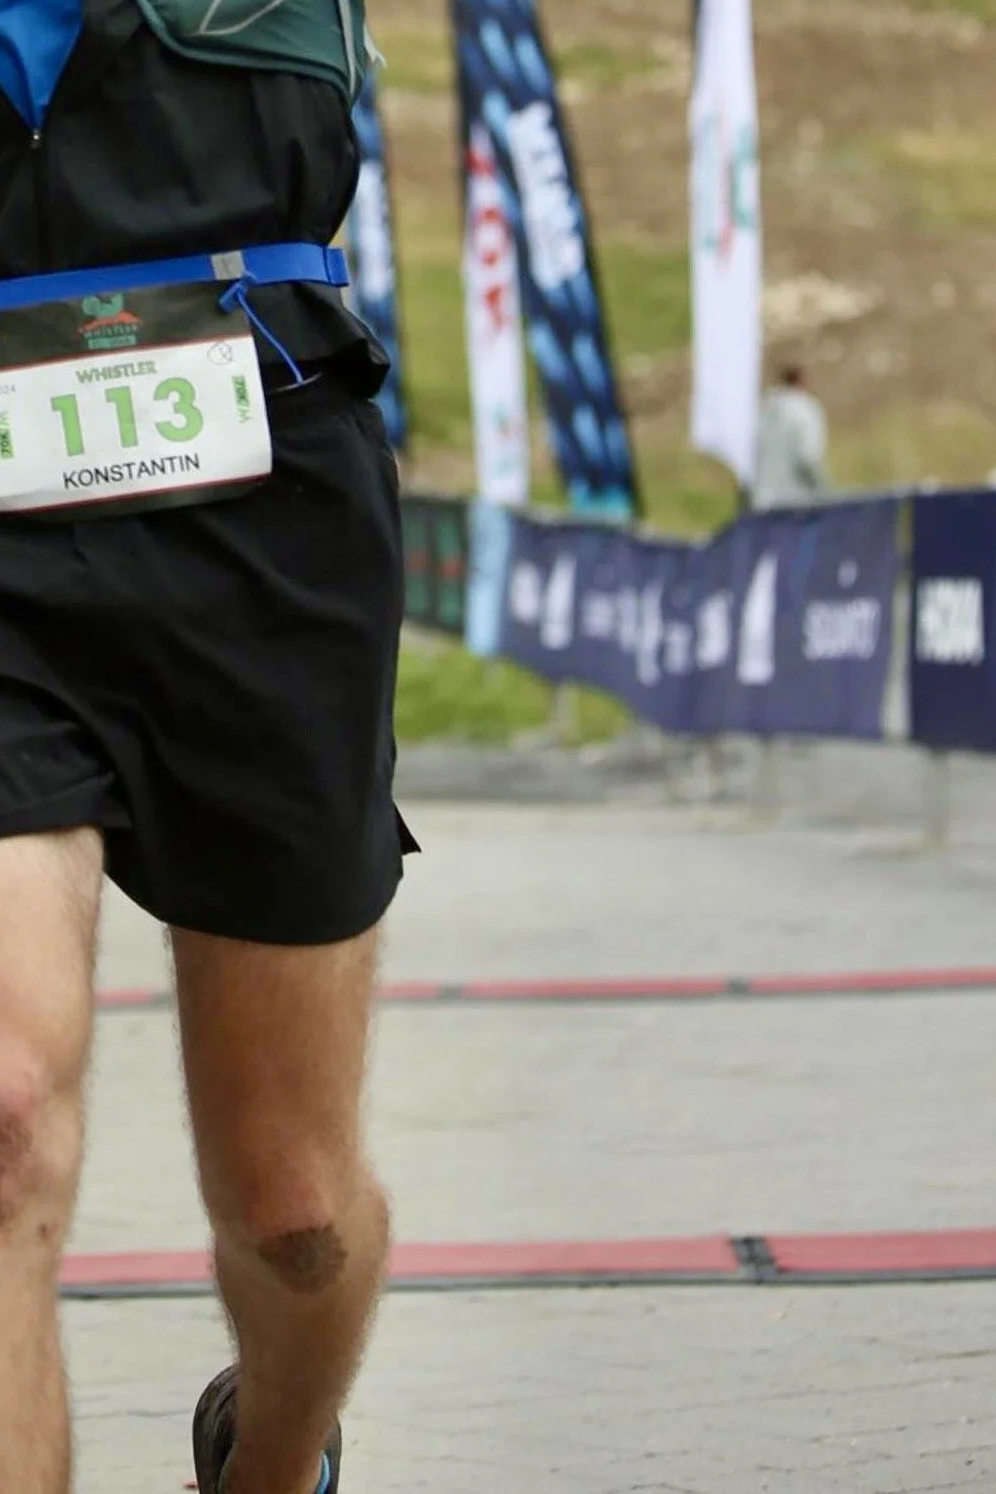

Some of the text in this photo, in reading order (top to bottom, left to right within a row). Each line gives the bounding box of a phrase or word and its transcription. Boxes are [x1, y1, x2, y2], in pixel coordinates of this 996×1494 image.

[75, 360, 158, 384] WHISTLER
[49, 376, 205, 458] 113
[62, 452, 201, 490] KONSTANTIN
